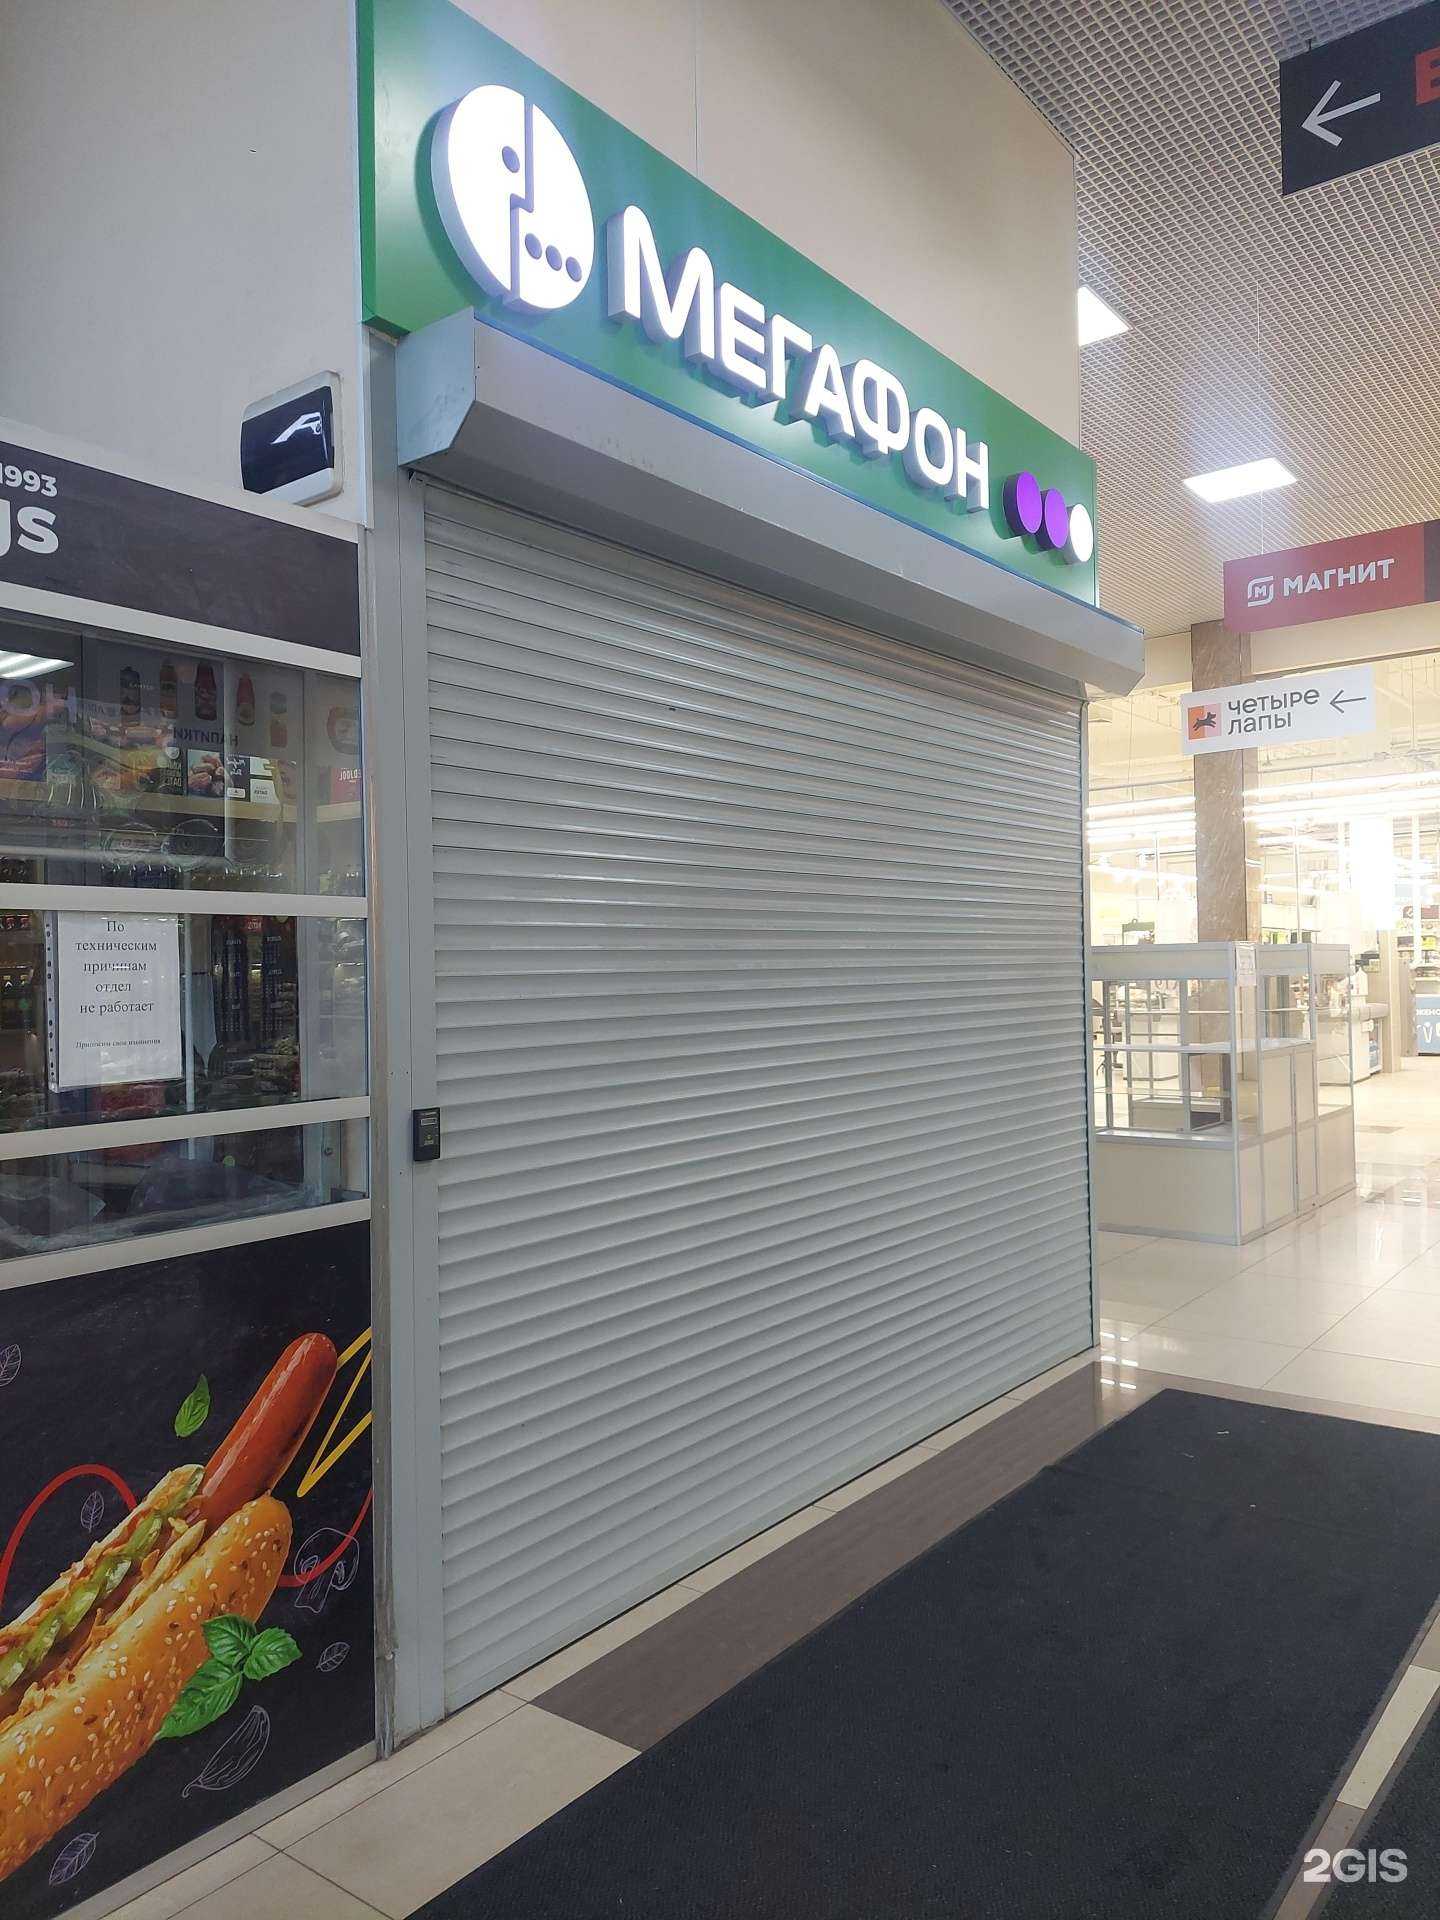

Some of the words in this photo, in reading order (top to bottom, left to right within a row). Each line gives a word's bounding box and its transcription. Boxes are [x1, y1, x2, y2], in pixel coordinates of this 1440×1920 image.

[0, 498, 59, 557] s
[1283, 558, 1395, 597] МАГНИТ
[1228, 688, 1320, 716] четыре
[1228, 712, 1292, 736] лапы
[106, 920, 125, 932] По
[75, 941, 157, 952] техническим
[83, 961, 147, 974] причинам
[95, 982, 131, 993] отдел
[80, 1003, 95, 1014] не
[99, 1000, 154, 1016] работает
